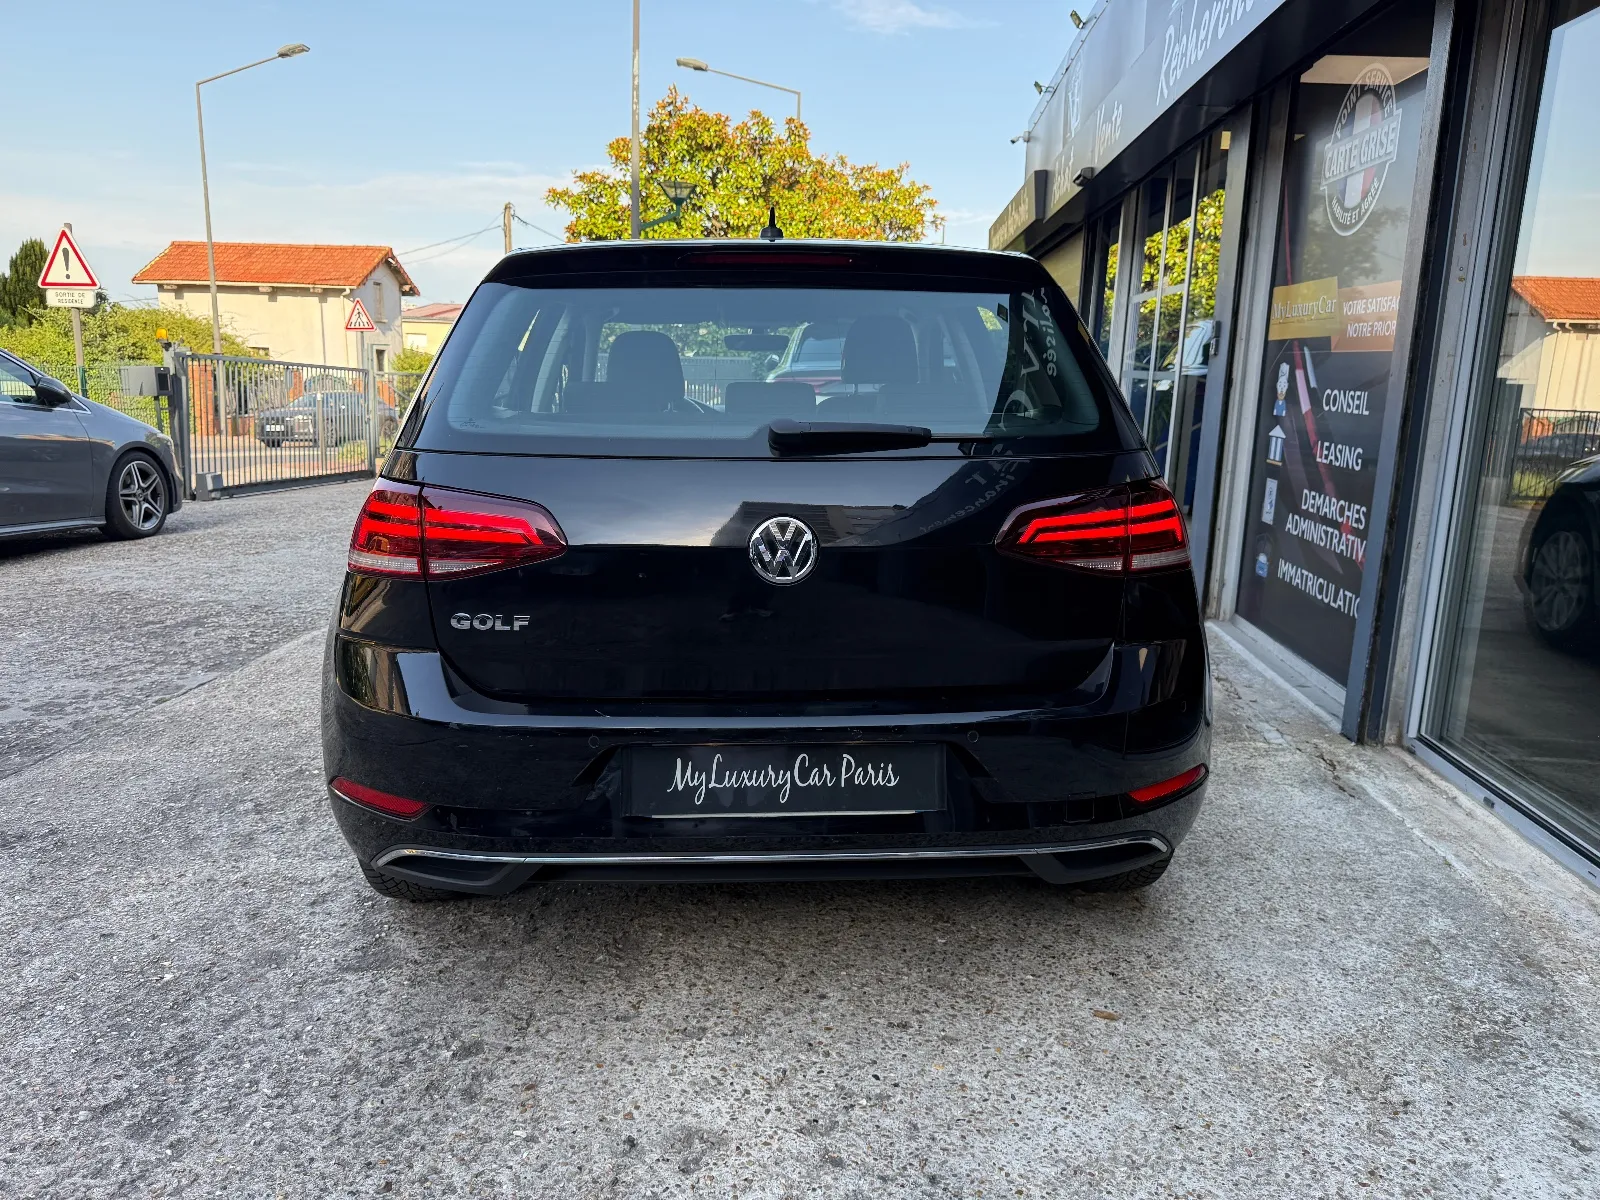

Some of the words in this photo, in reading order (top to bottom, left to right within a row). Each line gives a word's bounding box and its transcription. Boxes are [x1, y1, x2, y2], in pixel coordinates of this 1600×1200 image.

[1156, 0, 1254, 106] Recherc
[1336, 79, 1362, 139] POINT
[1364, 68, 1393, 118] SERVICE
[1094, 100, 1123, 165] Vente
[1325, 139, 1357, 178] CARTE
[1360, 121, 1397, 164] GRISE
[1352, 208, 1360, 224] ET
[1272, 296, 1337, 323] MyLuxuryCar
[1343, 299, 1366, 315] VOTRE
[1347, 322, 1372, 338] NOTRE
[1322, 388, 1370, 416] CONSEIL
[1316, 440, 1363, 471] LEASING
[1301, 488, 1367, 530] DEMARCHES
[1285, 512, 1367, 561] ADMINISTRATIV
[450, 612, 531, 631] GOLF
